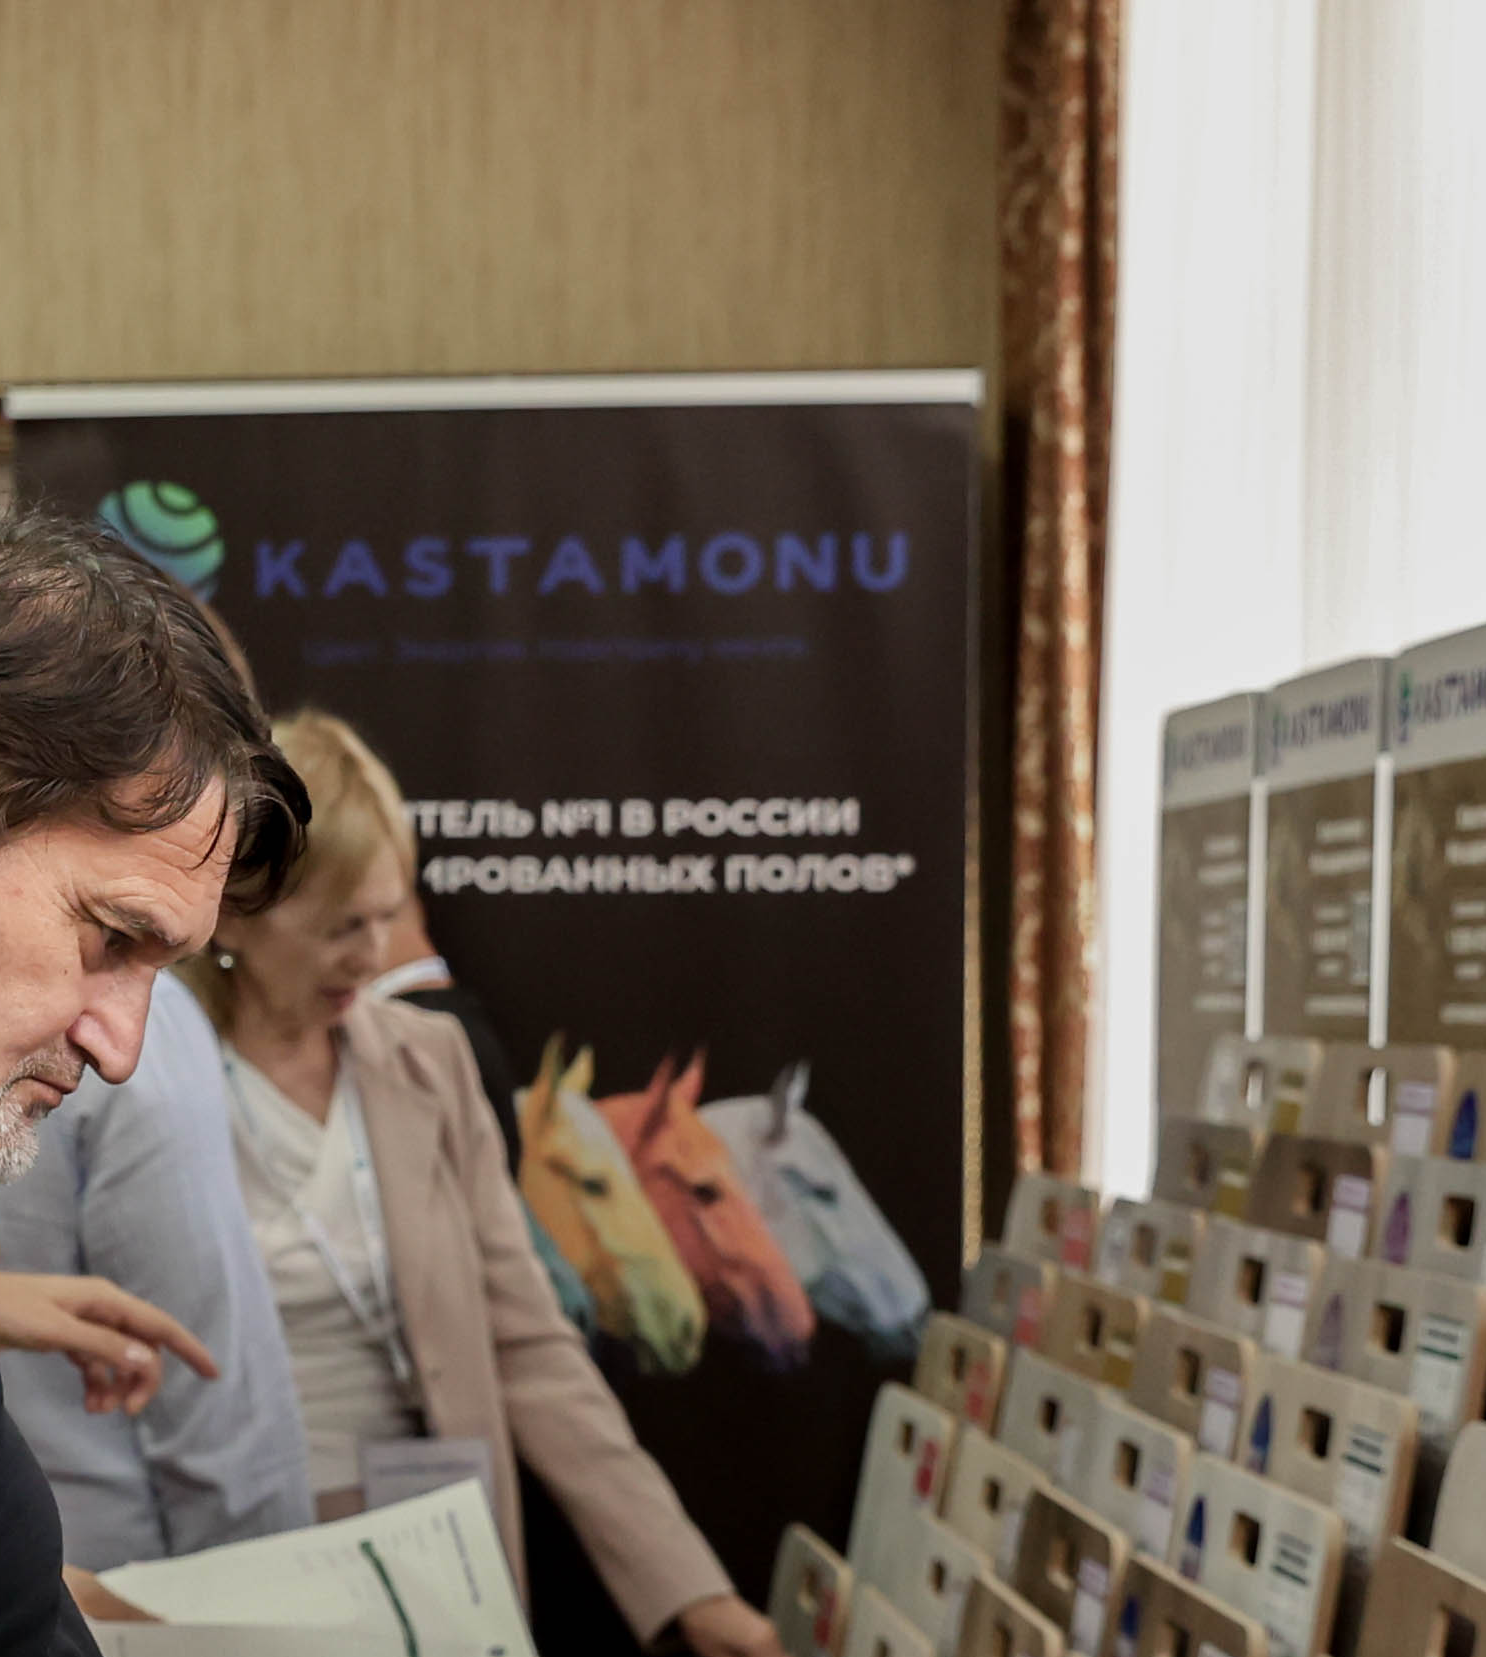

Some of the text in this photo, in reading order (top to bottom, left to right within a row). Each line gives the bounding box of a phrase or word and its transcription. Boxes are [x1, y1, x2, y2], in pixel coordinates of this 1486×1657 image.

[254, 531, 908, 598] KASTAMONU
[409, 798, 535, 838] ТЕЛЬ
[620, 798, 656, 838] В
[662, 797, 861, 838] РОССИИ
